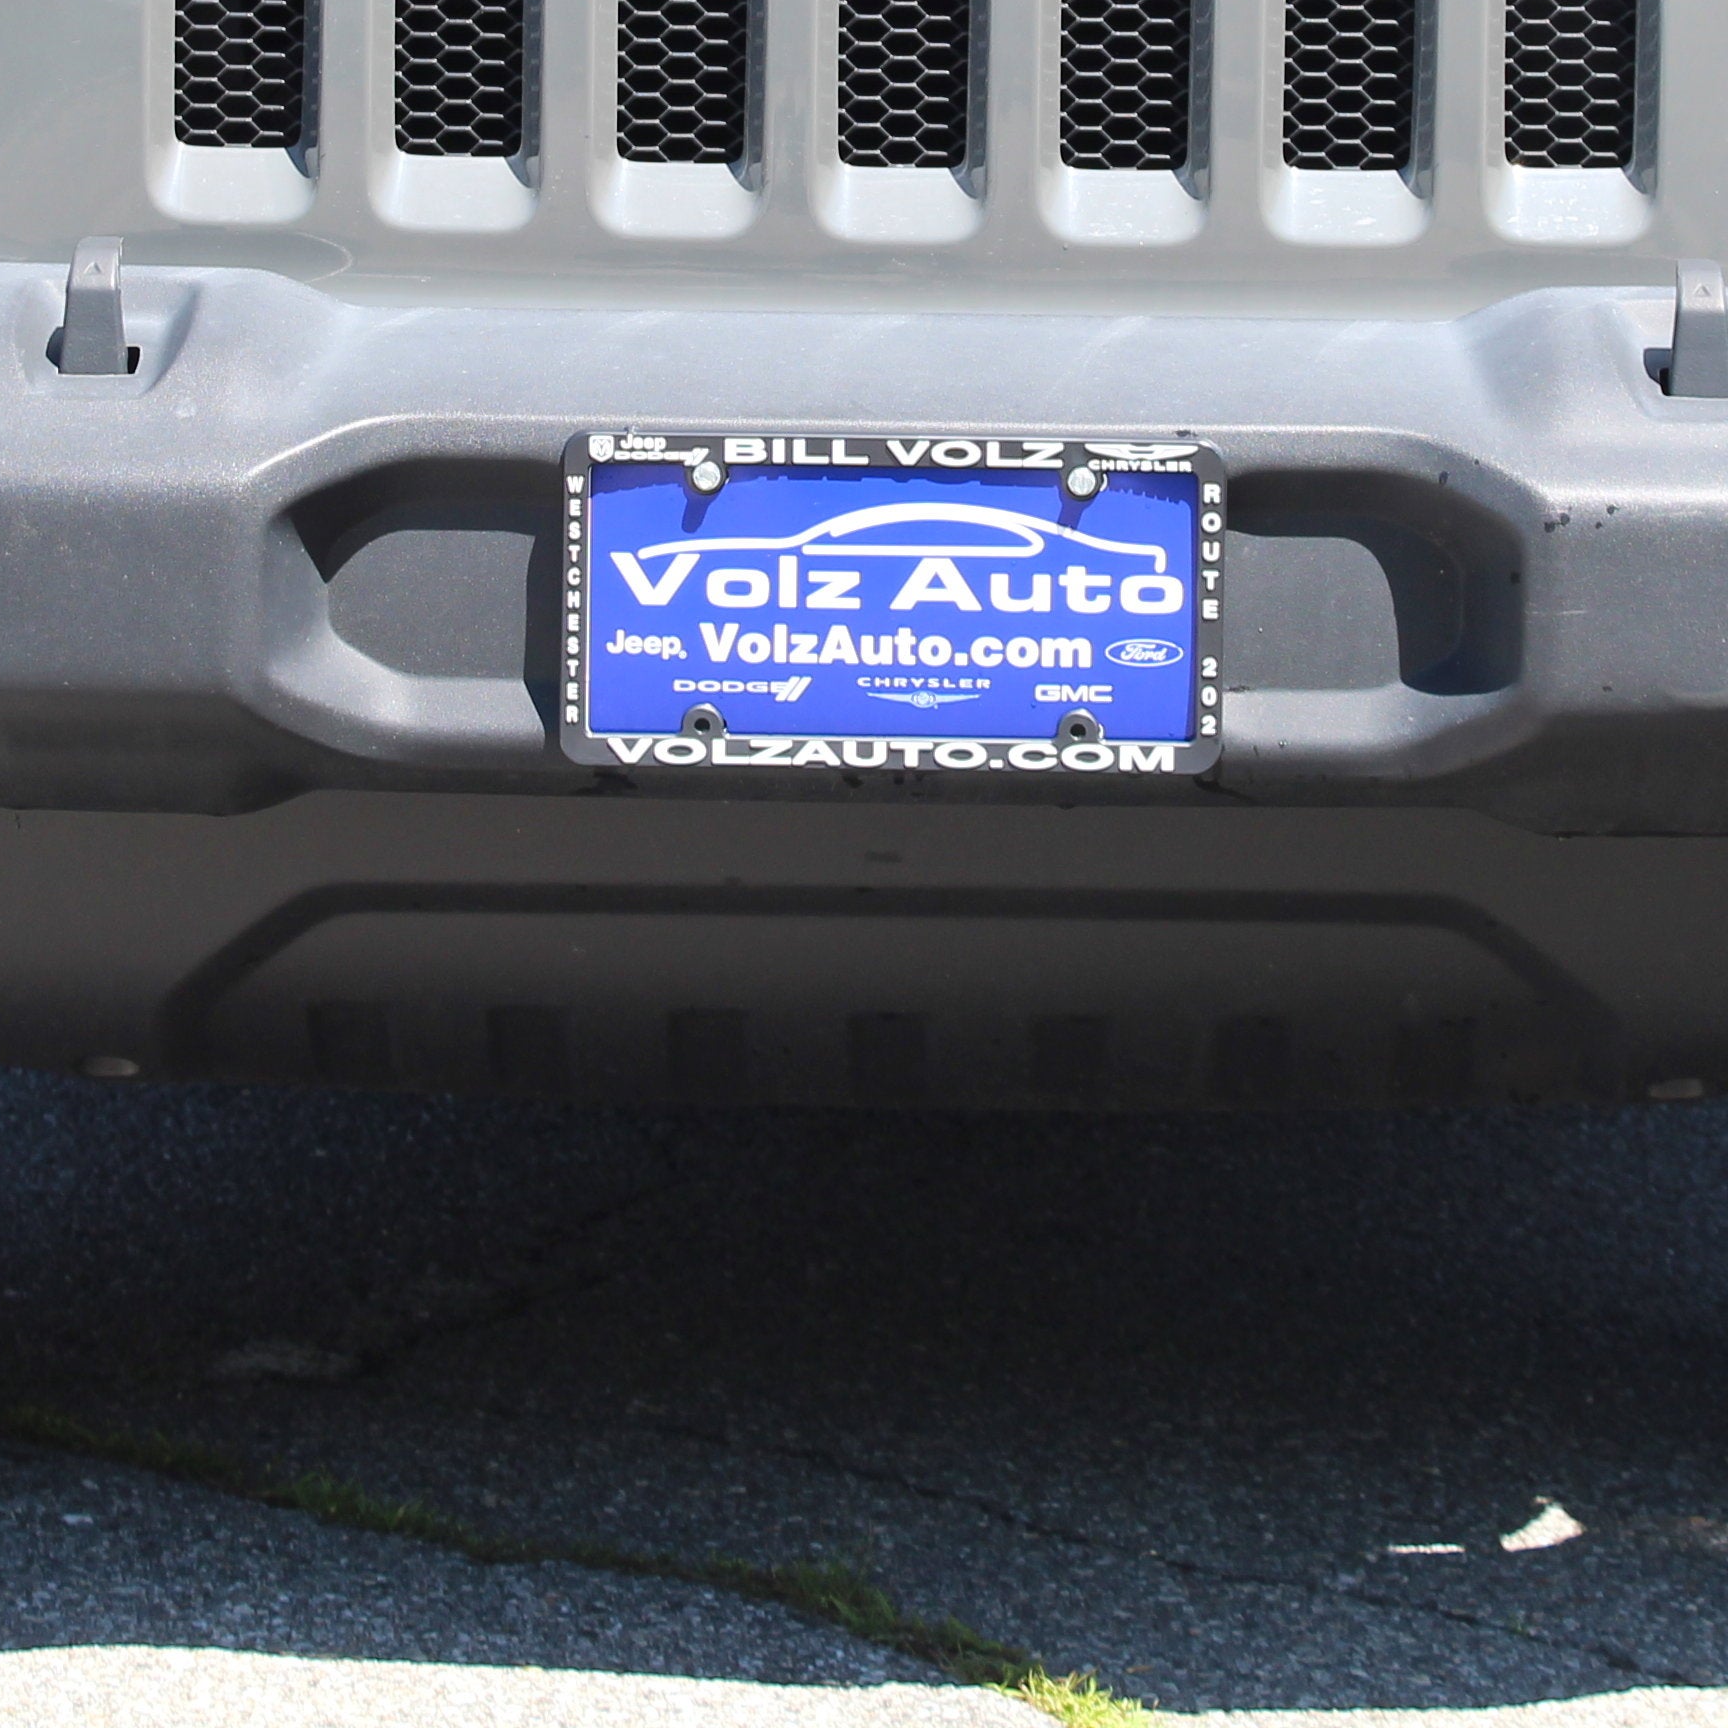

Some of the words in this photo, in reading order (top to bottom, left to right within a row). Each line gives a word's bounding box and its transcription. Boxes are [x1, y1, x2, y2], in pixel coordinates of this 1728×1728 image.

[619, 433, 667, 452] Jeep
[724, 437, 870, 466] BILL
[885, 439, 1065, 469] VOLZ
[1087, 458, 1193, 474] CHRYSLER
[1201, 482, 1222, 621] ROUTE
[609, 551, 863, 610] Volz
[888, 556, 1185, 615] Auto
[564, 475, 584, 725] WESTCHESTER
[605, 629, 682, 660] Jeep
[699, 622, 1093, 669] VolzAuto.com
[672, 678, 789, 694] DODGE
[856, 676, 992, 690] CHRYSLER
[1034, 683, 1114, 704] GMC
[1200, 656, 1219, 737] 202
[606, 736, 1176, 773] VOLZAUTO.COM
